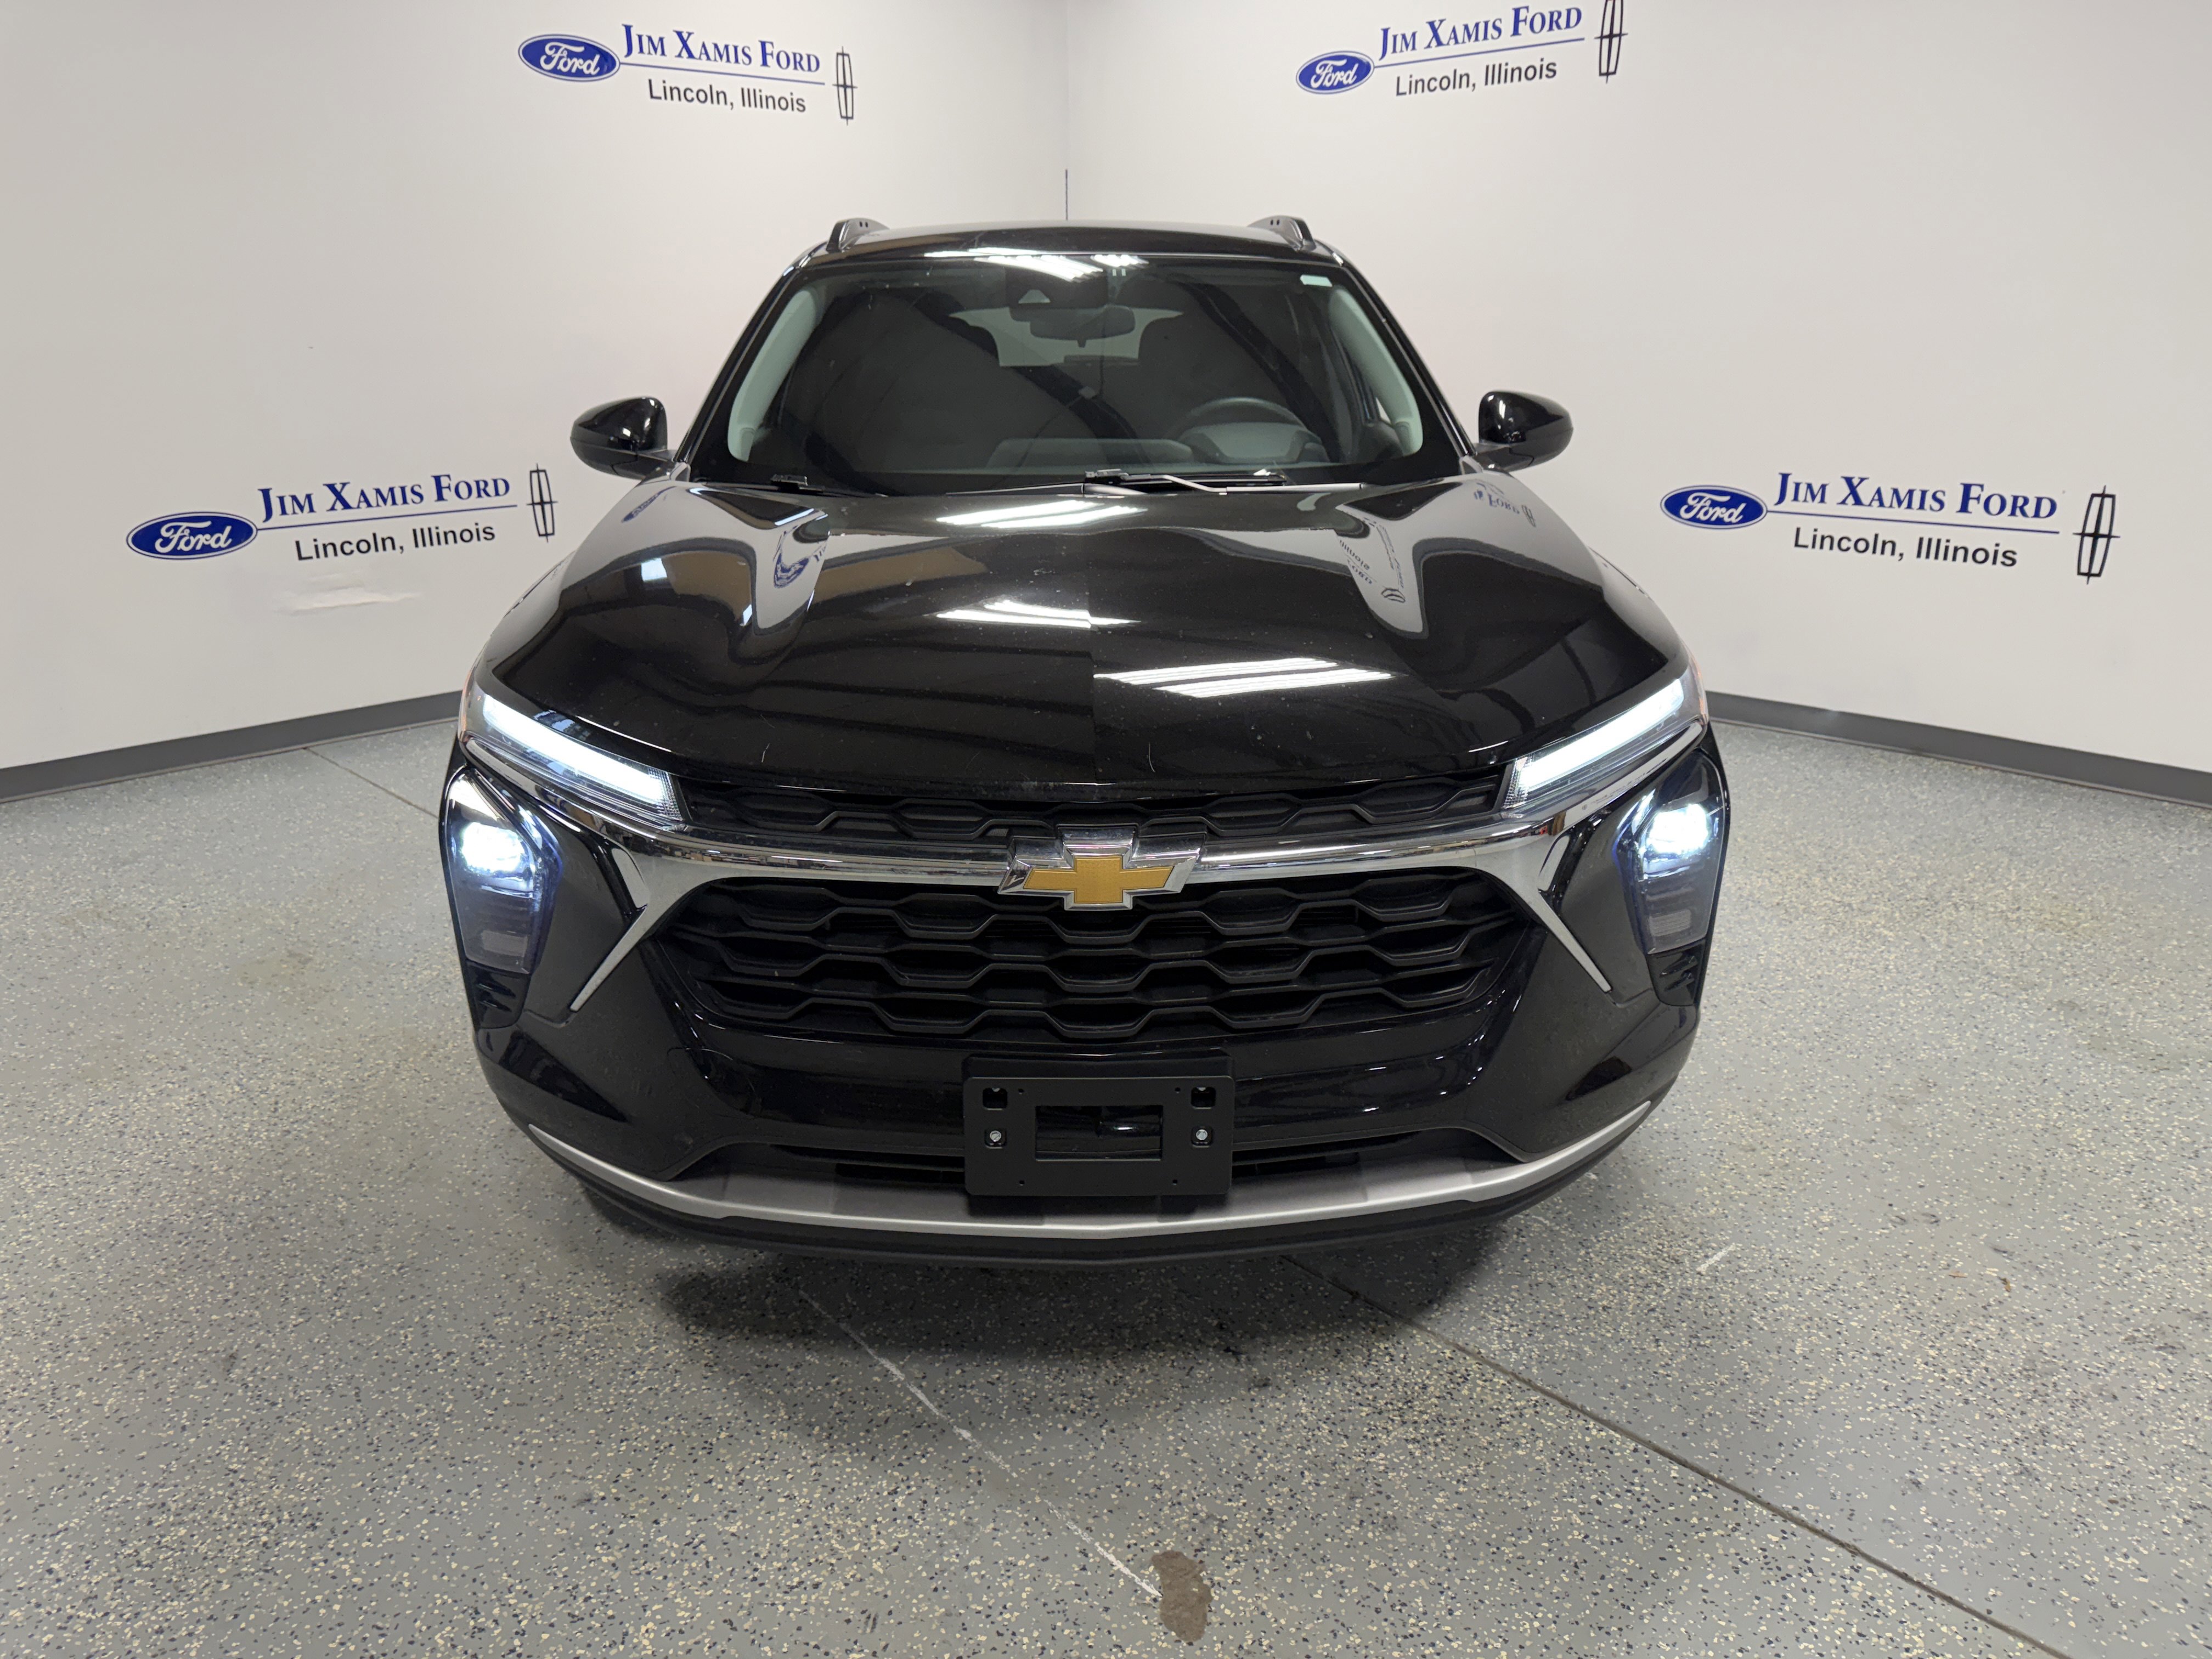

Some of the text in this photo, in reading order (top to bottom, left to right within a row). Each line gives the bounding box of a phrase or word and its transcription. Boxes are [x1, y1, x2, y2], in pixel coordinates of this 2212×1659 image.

[622, 24, 820, 72] JIM XAMIS FORD
[1379, 5, 1582, 60] JIM XAMIS FORD
[540, 41, 600, 76] Ford
[1311, 59, 1357, 88] Ford
[1396, 58, 1557, 96] Lincoln, Illinois
[648, 78, 806, 112] Lincoln, Illinois
[257, 474, 510, 523] JIM XAMIS FORD
[1679, 492, 1743, 524] Ford
[1774, 472, 2057, 519] JIM XAMIS FORD
[155, 521, 232, 554] Ford
[295, 522, 495, 561] Lincoln, Illinois
[1794, 527, 2018, 567] Lincoln, Illinois
